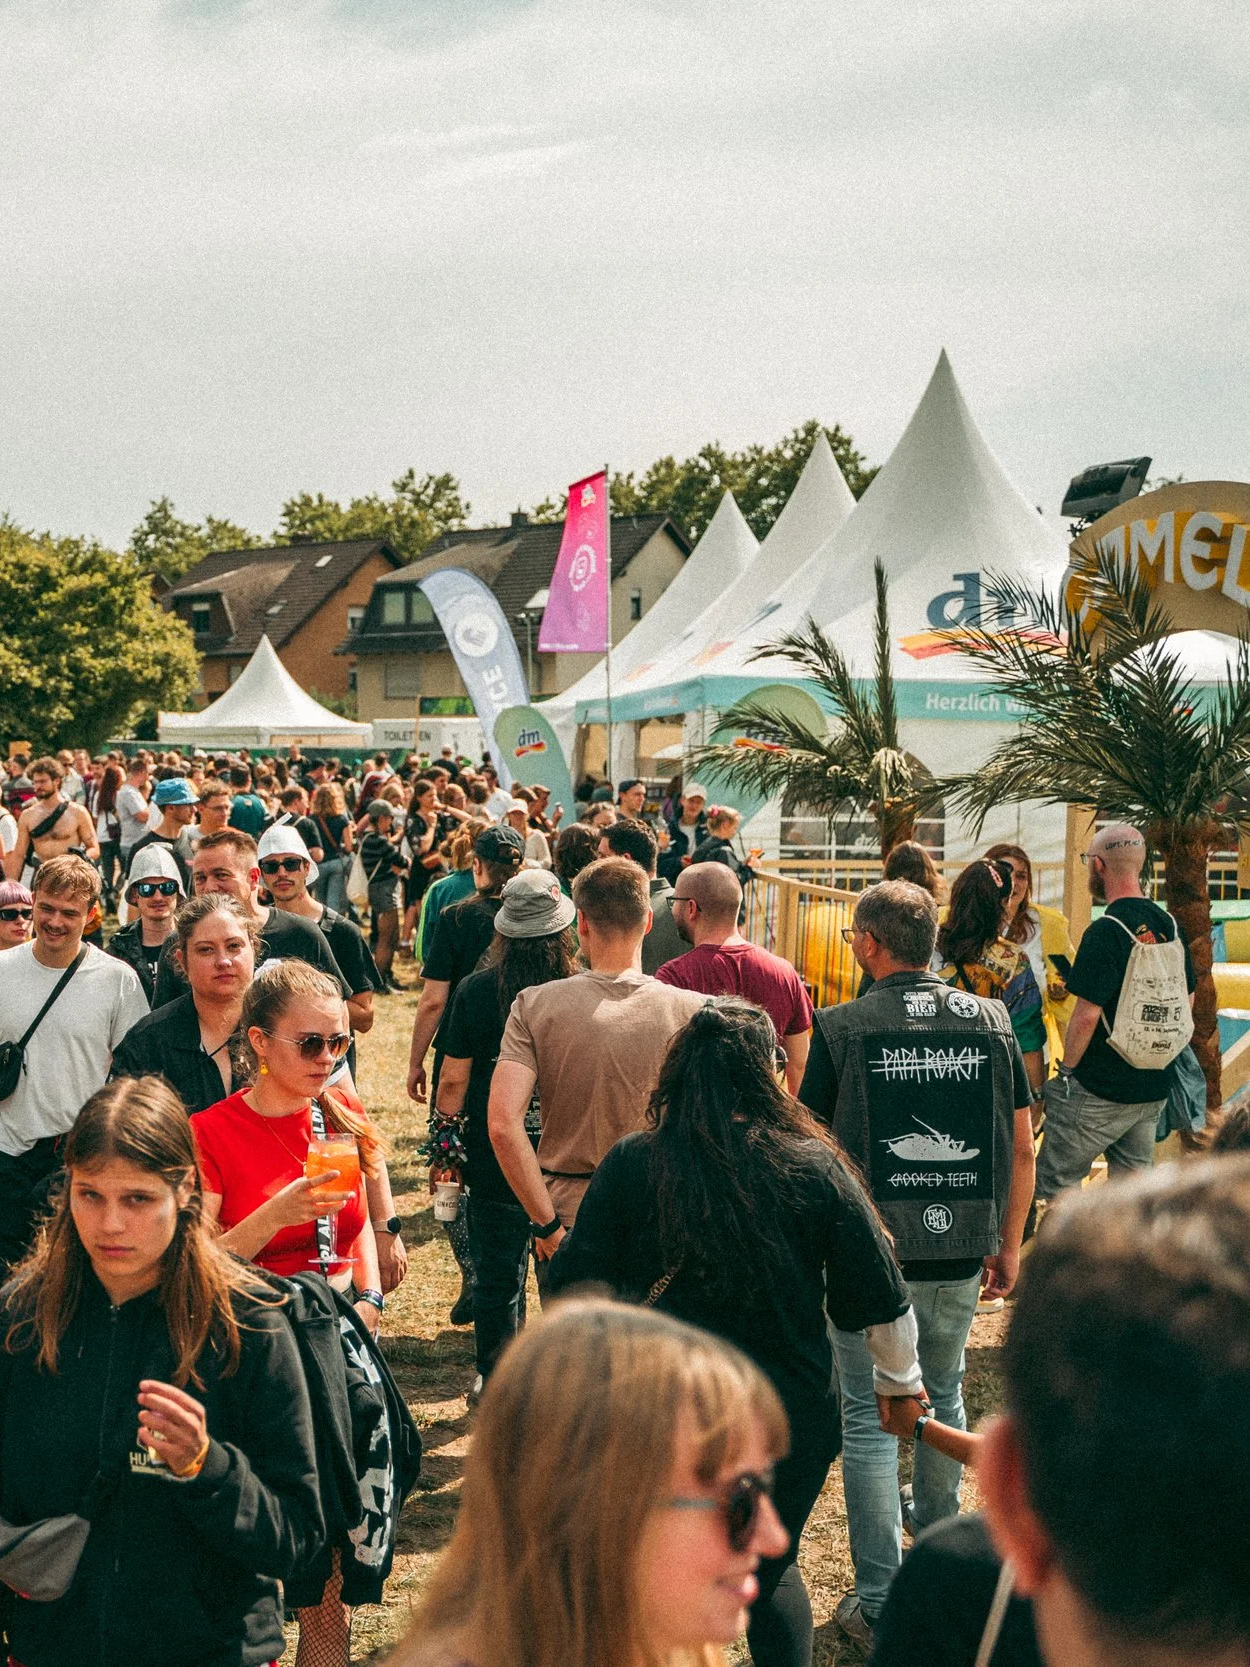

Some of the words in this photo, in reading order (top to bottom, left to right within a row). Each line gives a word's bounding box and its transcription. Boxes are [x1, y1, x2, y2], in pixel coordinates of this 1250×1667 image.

[481, 664, 510, 709] GE
[926, 692, 1000, 712] Herzlich
[384, 730, 432, 742] TOILETEN
[518, 728, 540, 746] dm
[906, 1003, 937, 1013] BIER
[882, 1047, 921, 1083] PAPA
[924, 1047, 979, 1081] ROACH
[889, 1172, 944, 1188] CROOKED
[946, 1171, 978, 1187] TEETH
